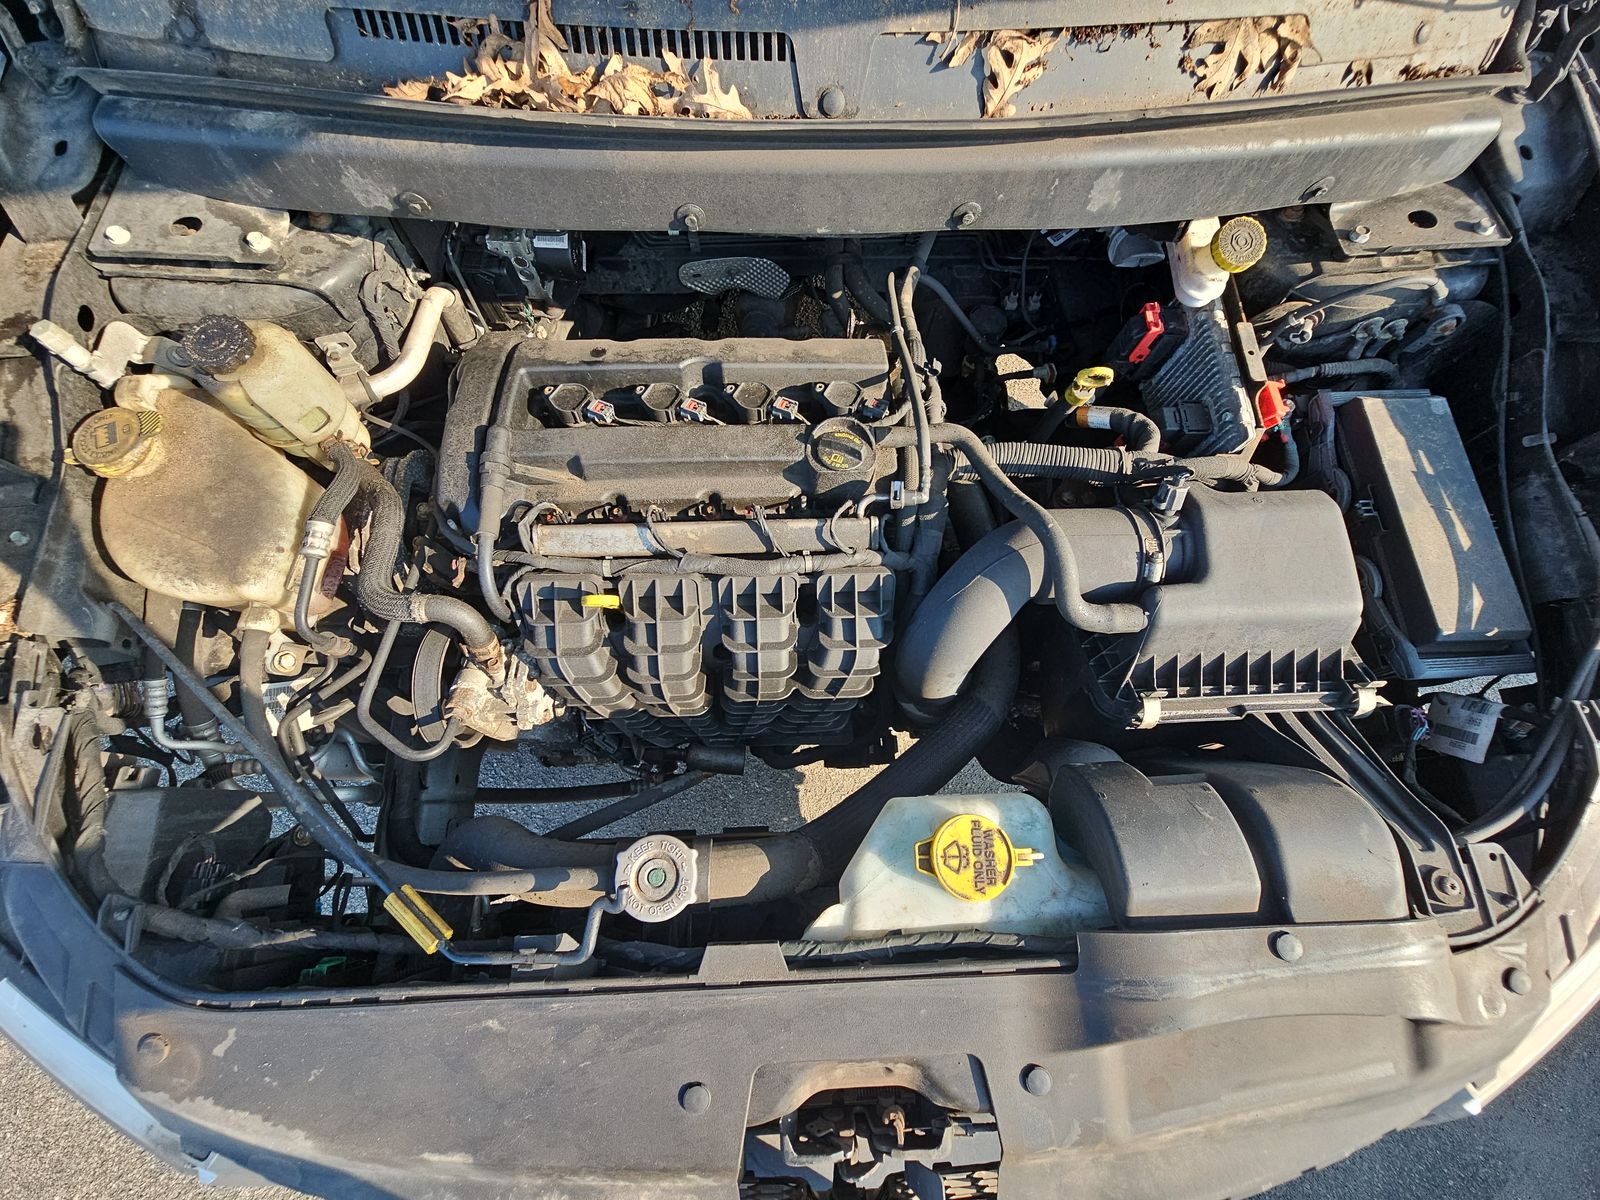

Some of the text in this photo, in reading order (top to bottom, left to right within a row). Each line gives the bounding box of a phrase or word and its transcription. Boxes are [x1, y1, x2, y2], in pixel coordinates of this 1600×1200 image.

[629, 840, 687, 862] KEEP TIGHT
[971, 820, 986, 895] FLUID ONLY
[983, 829, 997, 886] WASHER
[627, 878, 690, 916] NOT OPEN HOT
